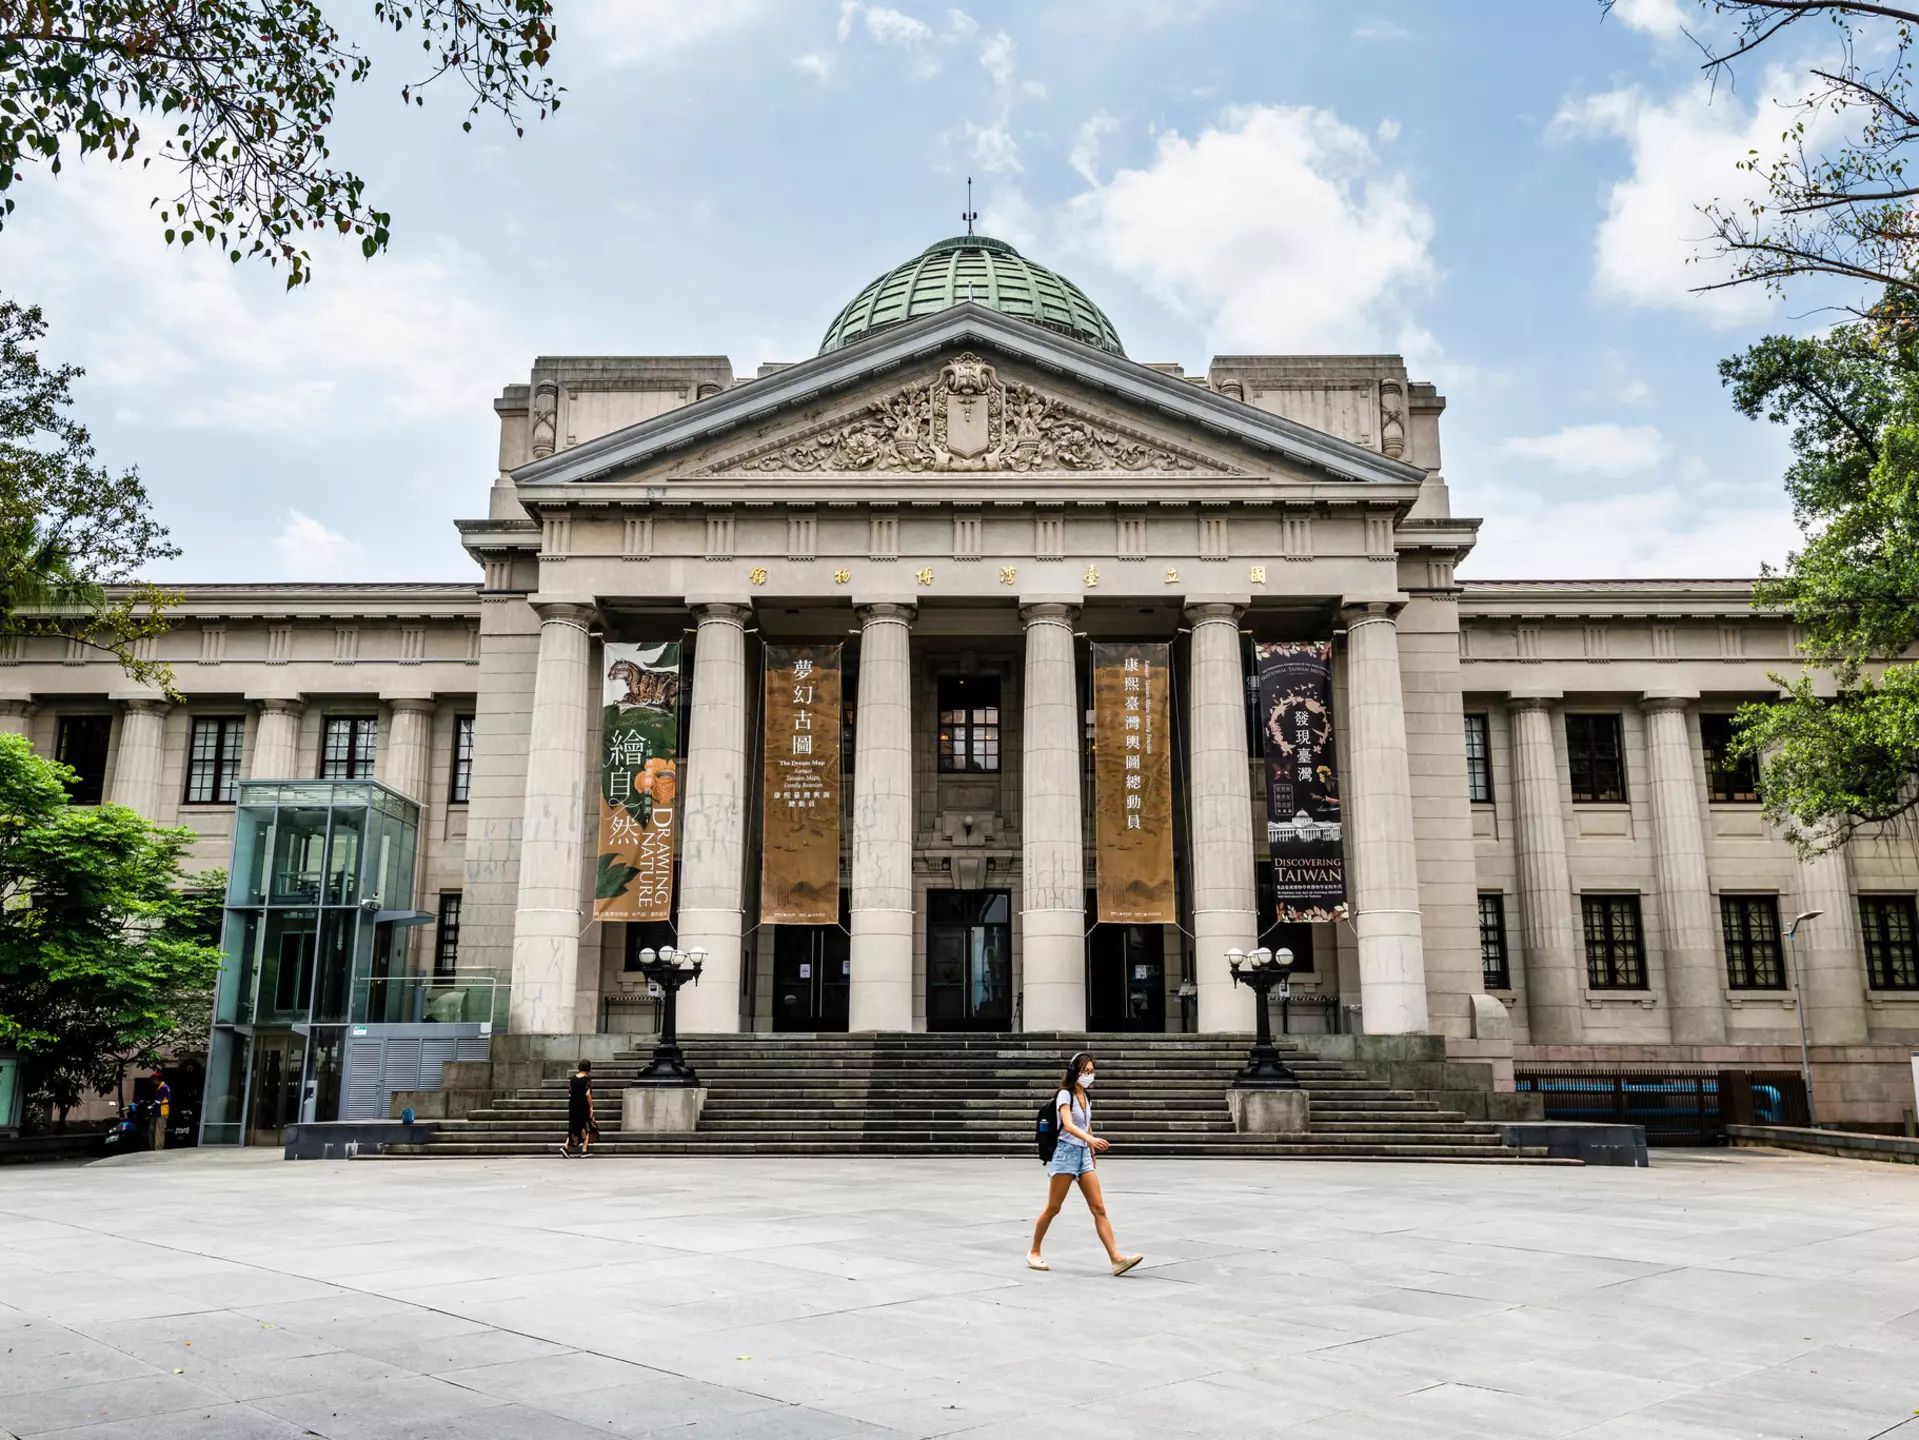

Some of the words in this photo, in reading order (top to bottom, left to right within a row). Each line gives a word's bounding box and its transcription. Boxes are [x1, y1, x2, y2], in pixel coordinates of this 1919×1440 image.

[793, 660, 813, 755] 夢幻古圖
[1124, 657, 1141, 830] 康熙臺灣輿圖總動員
[1295, 711, 1312, 782] 發現臺灣
[604, 728, 647, 846] 繪自然
[639, 832, 656, 907] NATURE
[653, 807, 673, 904] DRAWING
[1274, 857, 1341, 867] DISCOVERING
[1274, 867, 1342, 882] TAIWAN
